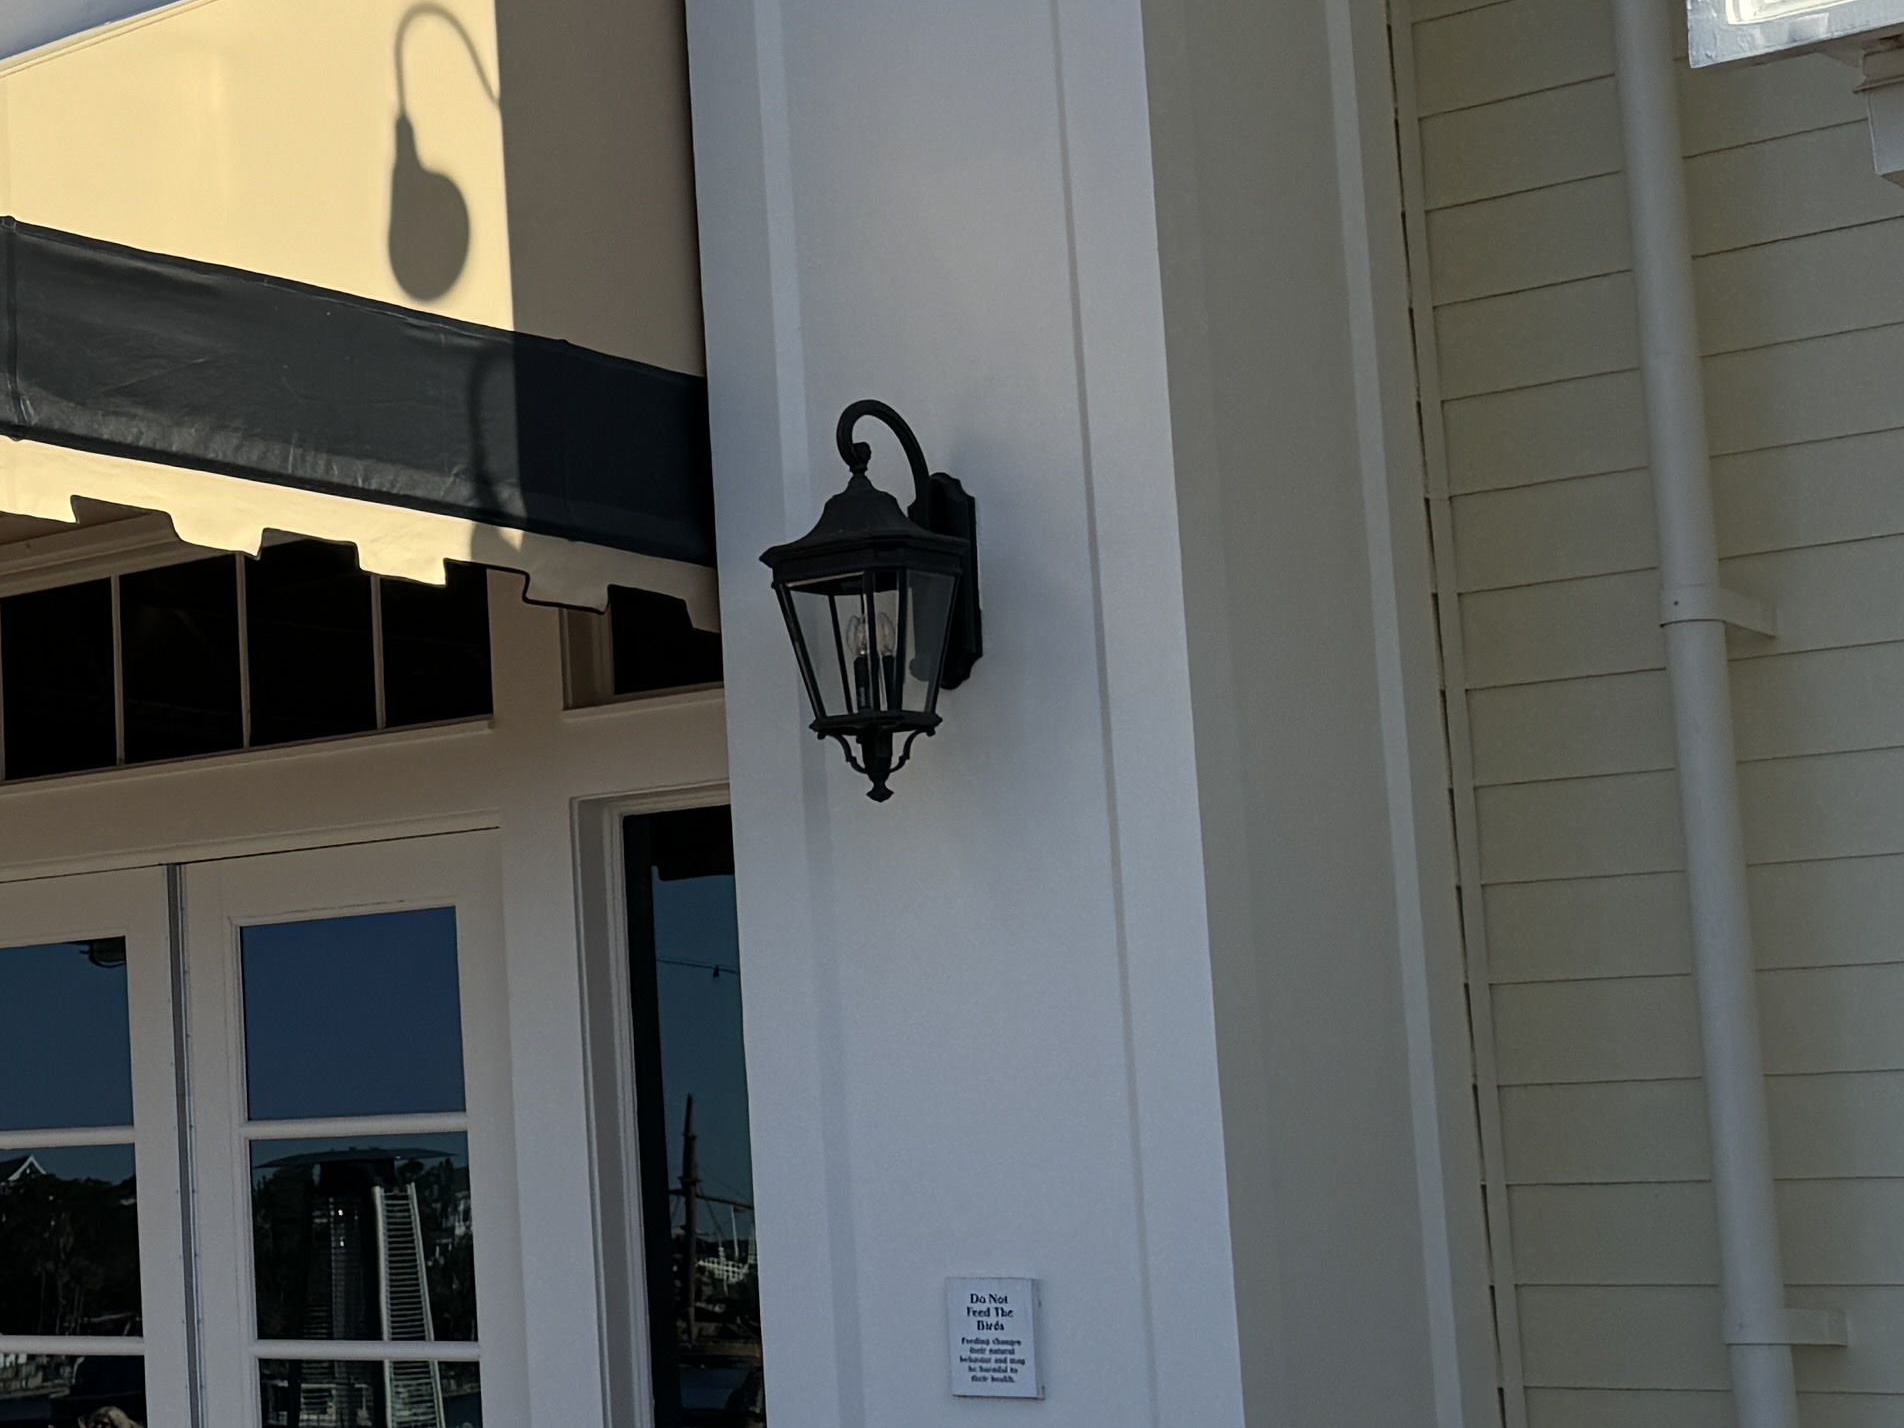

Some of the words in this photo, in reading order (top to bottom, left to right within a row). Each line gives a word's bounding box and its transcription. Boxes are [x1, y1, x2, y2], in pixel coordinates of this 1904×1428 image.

[970, 1293, 986, 1304] Do
[989, 1293, 1008, 1304] Not
[966, 1306, 991, 1317] Feed
[994, 1306, 1013, 1318] The
[977, 1320, 1005, 1331] Birds
